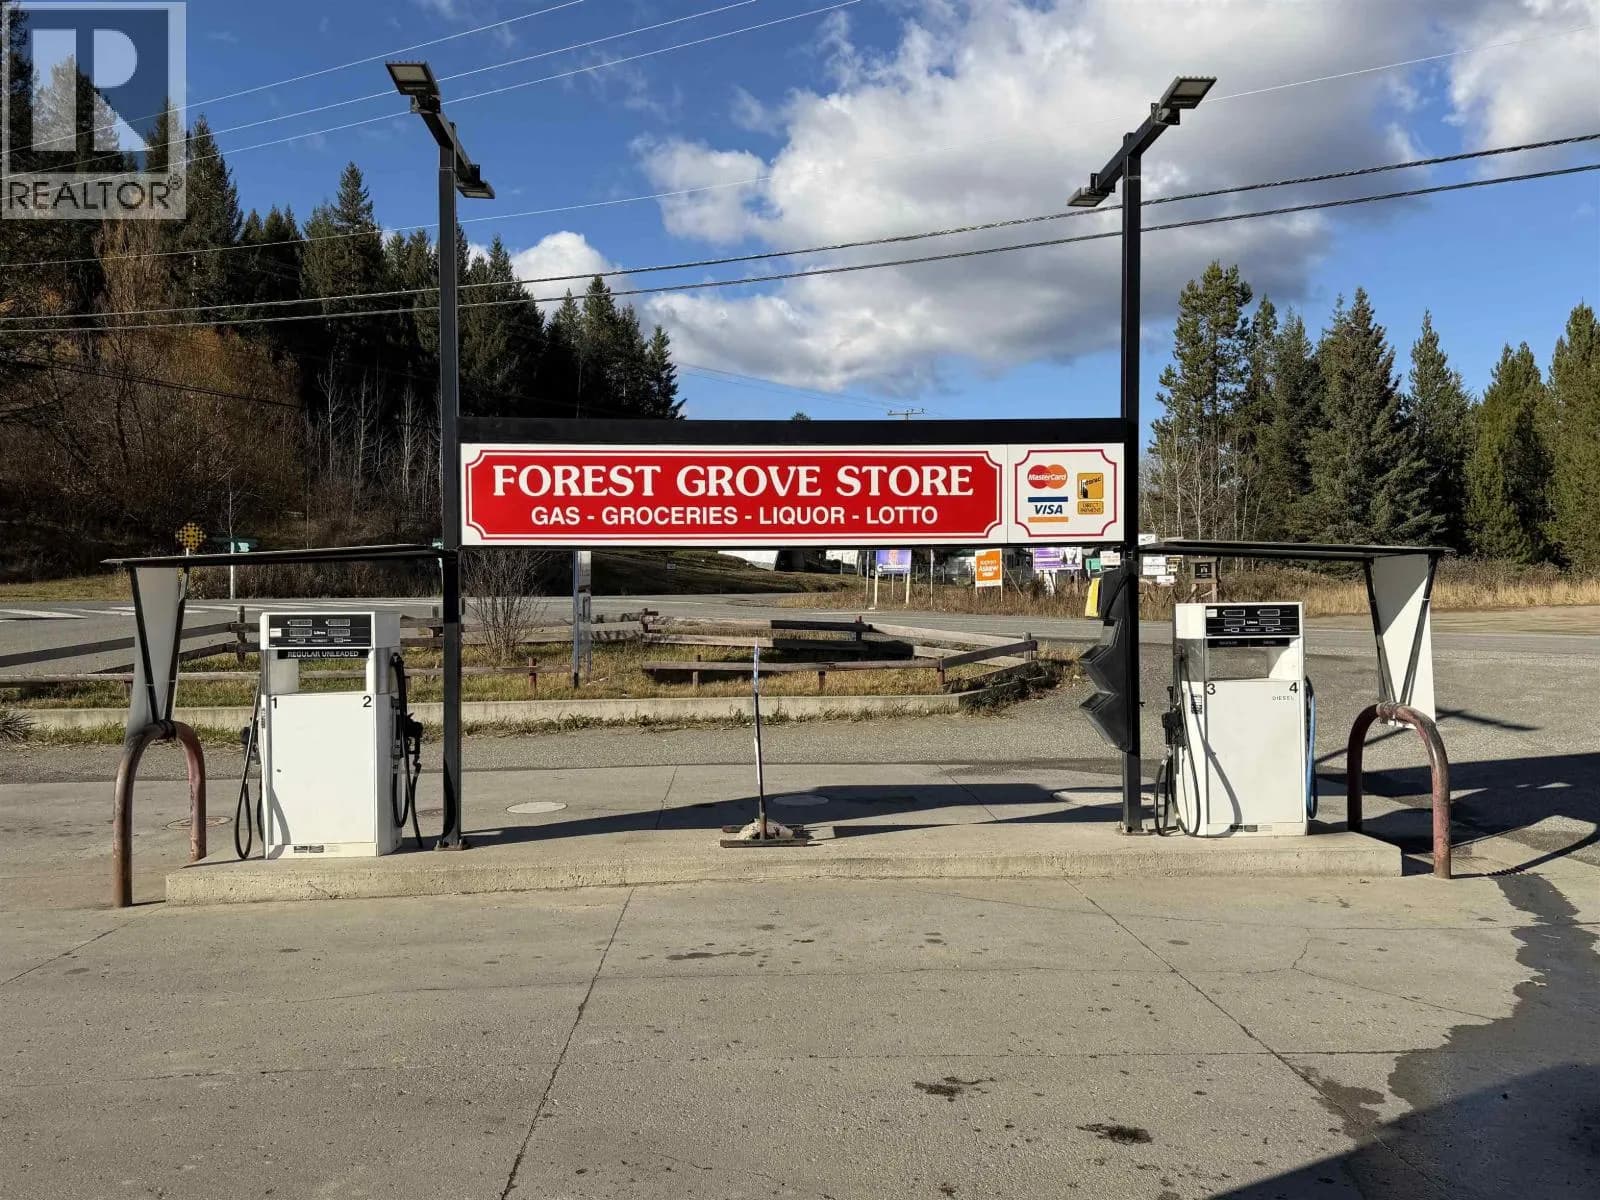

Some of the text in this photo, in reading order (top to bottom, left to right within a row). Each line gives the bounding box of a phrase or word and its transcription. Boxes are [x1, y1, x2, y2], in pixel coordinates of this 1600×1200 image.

[492, 464, 974, 497] FOREST GROVE STORE
[1028, 473, 1067, 481] MasterCard
[531, 506, 581, 526] GAS
[601, 506, 738, 526] GROCERIES
[759, 505, 845, 526] LIQUOR
[866, 505, 938, 525] LOTTO
[1034, 504, 1063, 515] VISA
[1206, 683, 1216, 695] 3
[1289, 682, 1298, 693] 4
[271, 697, 278, 709] 1
[362, 695, 372, 708] 2
